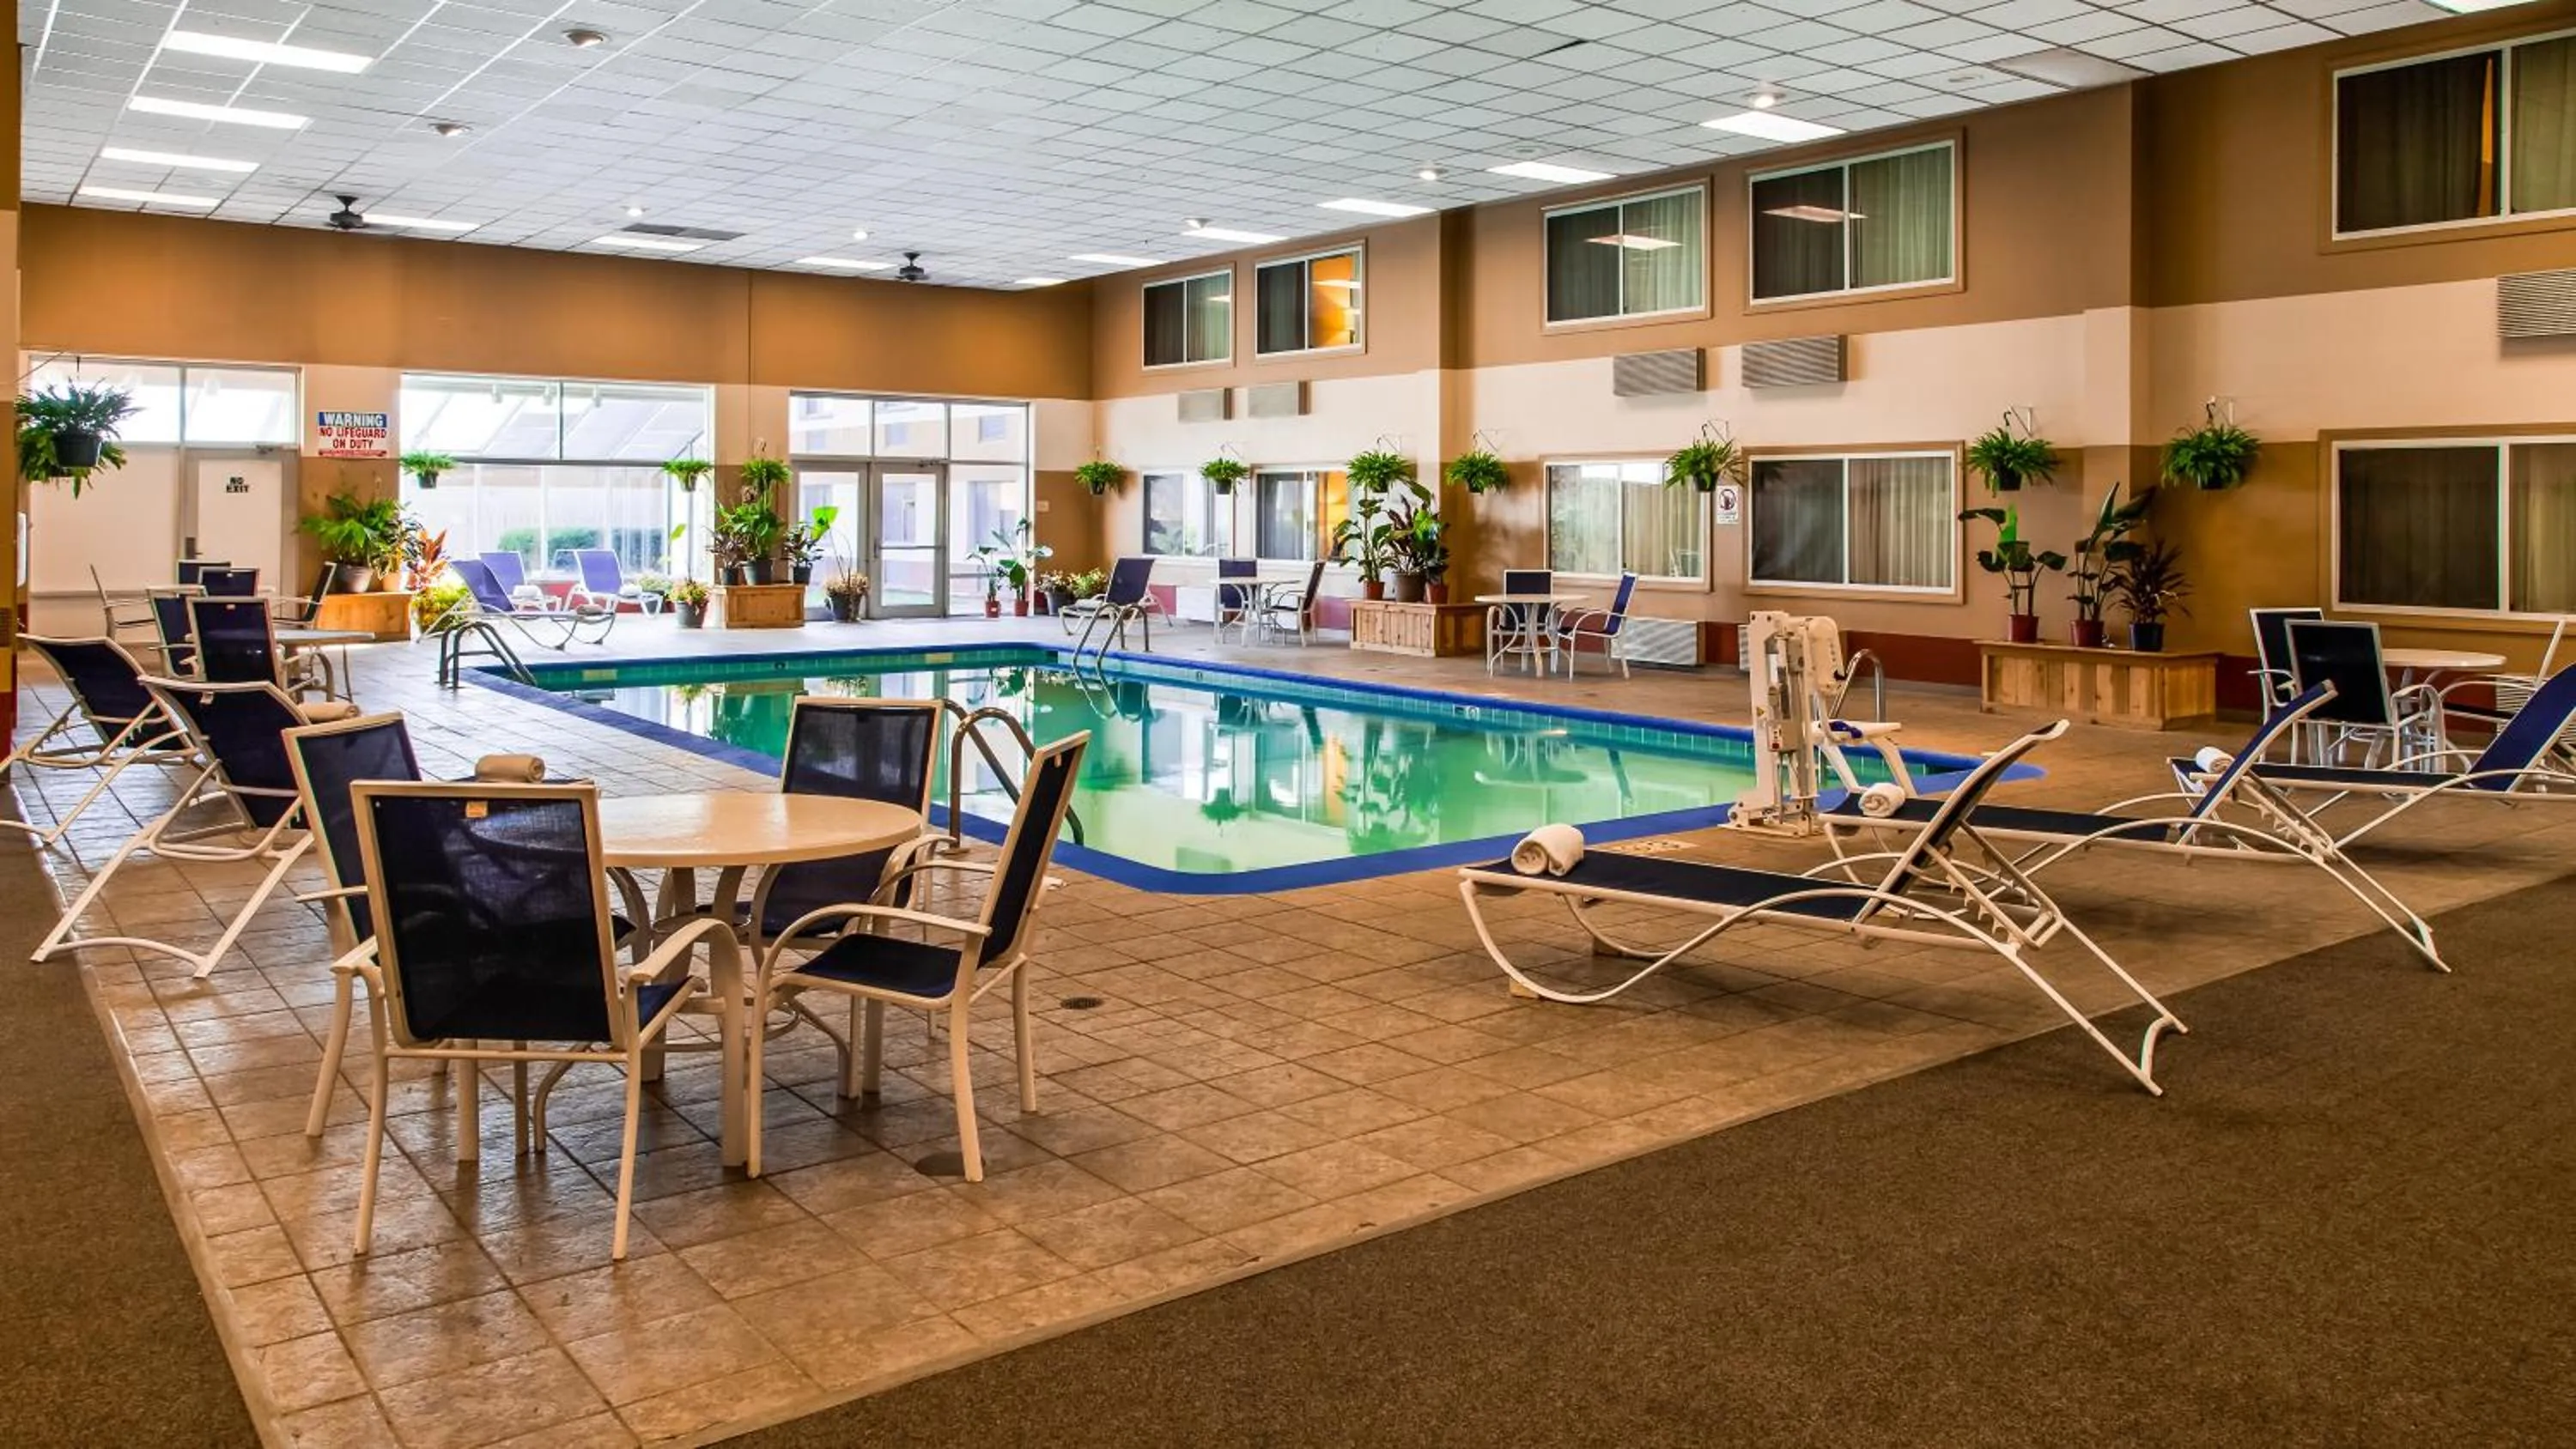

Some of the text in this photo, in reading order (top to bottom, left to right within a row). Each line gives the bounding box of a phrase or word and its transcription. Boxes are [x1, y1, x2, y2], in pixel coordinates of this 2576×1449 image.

[324, 412, 384, 427] WARNING
[319, 427, 386, 439] NO LIFEGUARD
[332, 439, 374, 449] ON DUTY
